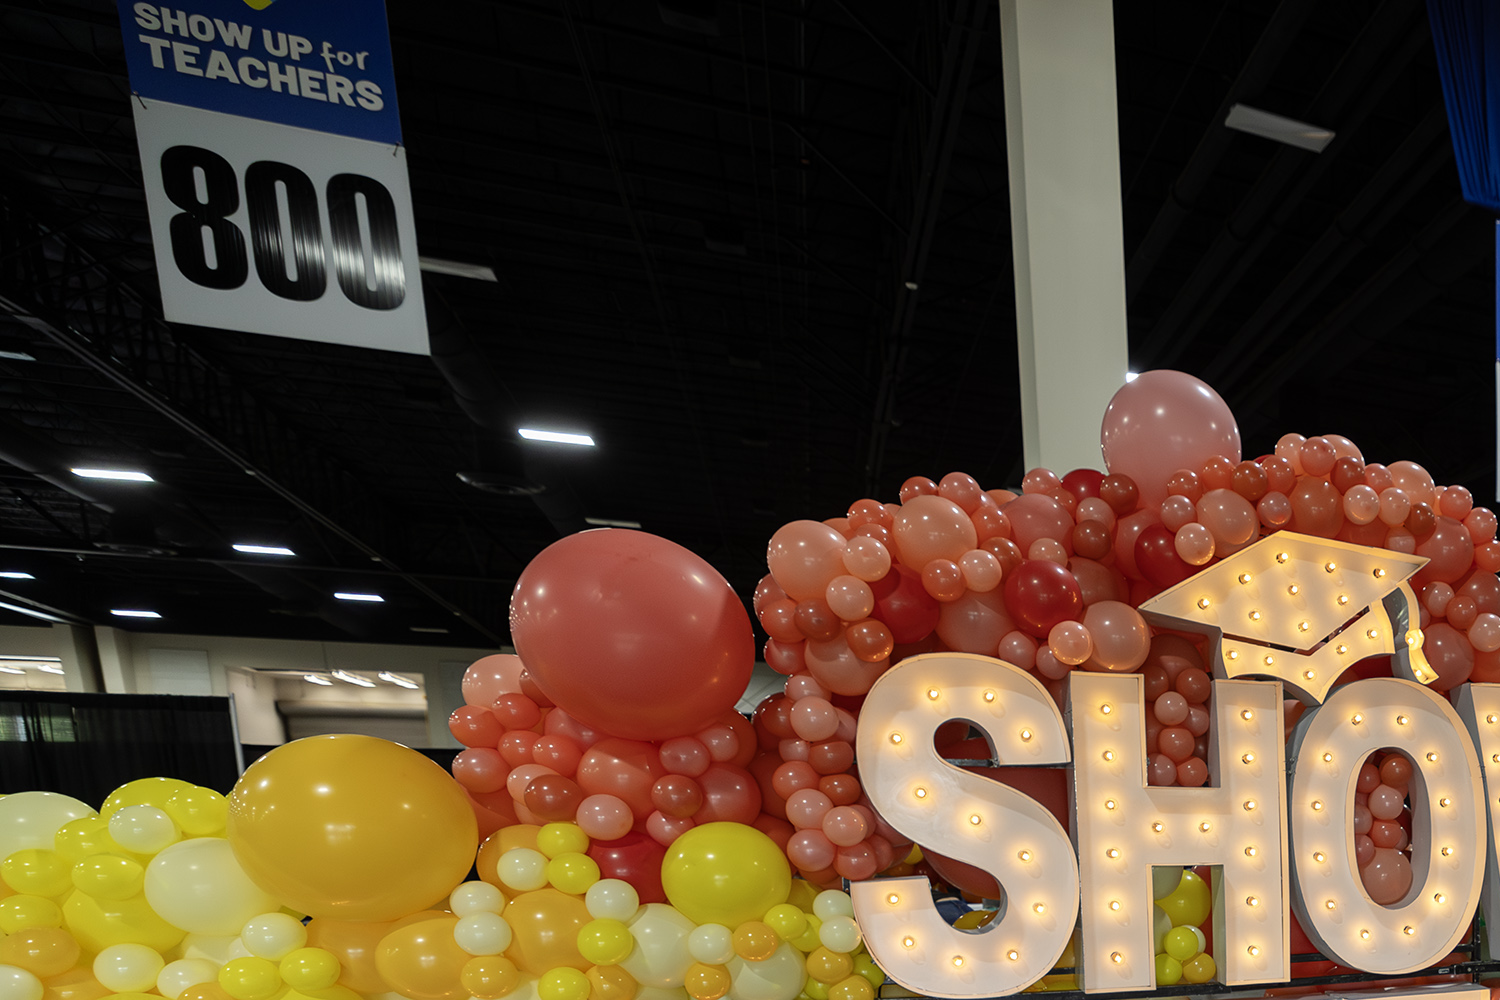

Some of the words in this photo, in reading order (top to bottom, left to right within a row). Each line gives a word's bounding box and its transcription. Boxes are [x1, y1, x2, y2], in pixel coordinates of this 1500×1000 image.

[134, 3, 252, 50] SHOW
[262, 29, 313, 61] UP
[320, 42, 369, 73] for
[139, 34, 384, 111] TEACHERS
[160, 145, 406, 311] 800
